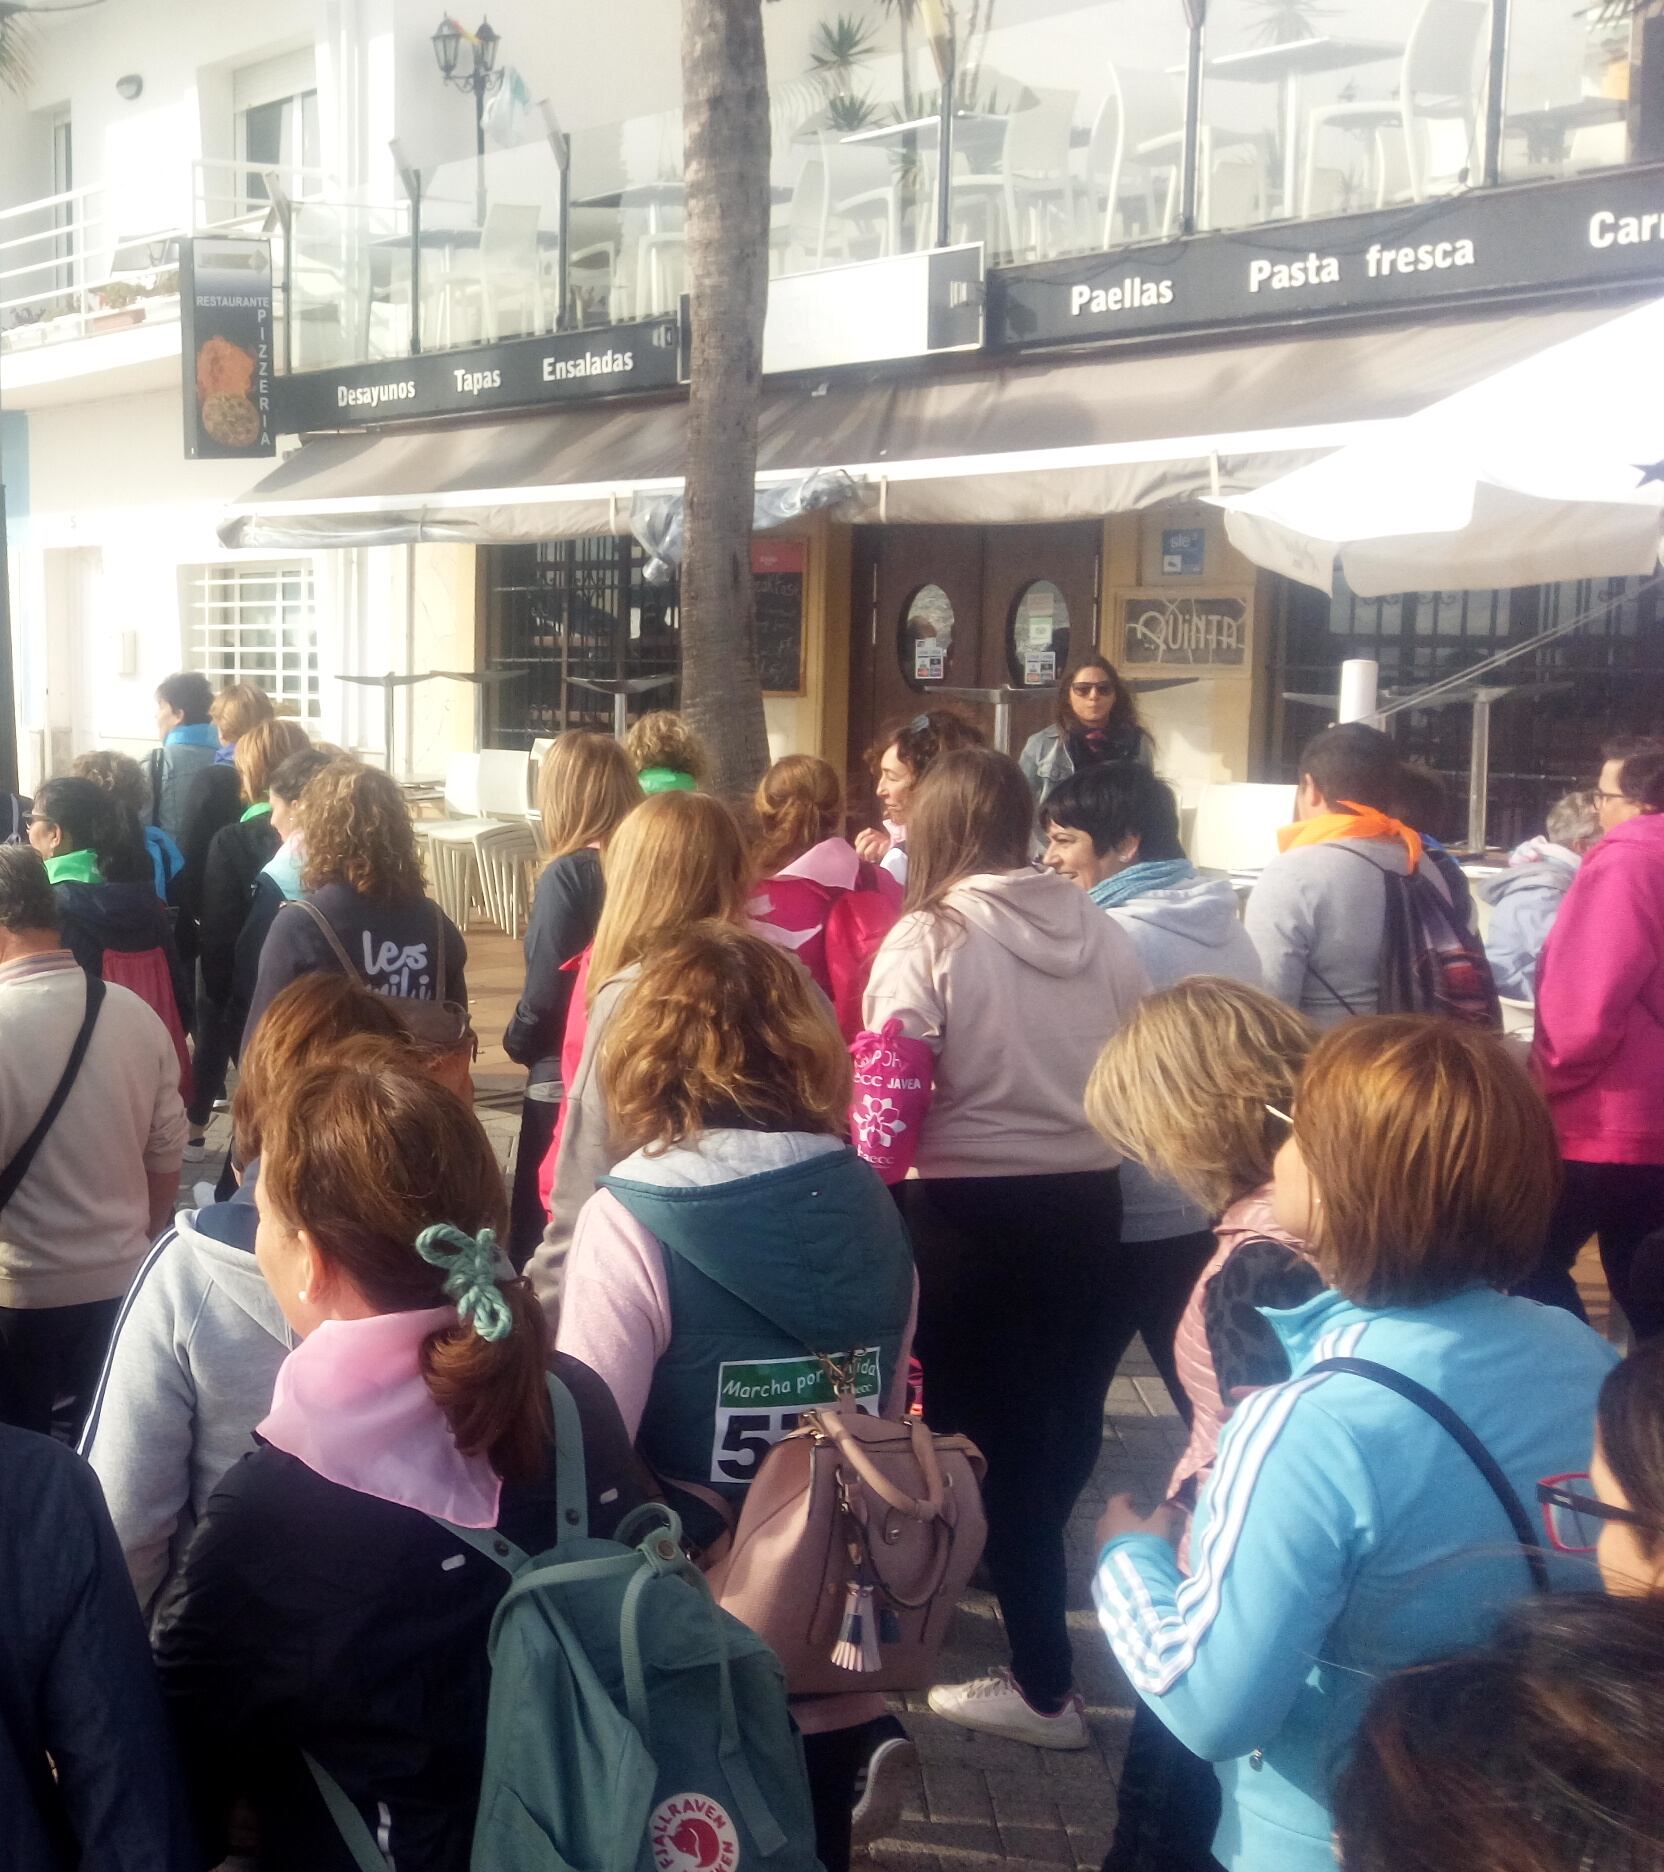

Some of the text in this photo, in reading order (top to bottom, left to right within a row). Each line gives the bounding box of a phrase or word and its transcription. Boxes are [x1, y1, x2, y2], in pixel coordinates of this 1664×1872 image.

[196, 295, 270, 308] RESTAURANTE
[1071, 277, 1174, 315] Paellas
[1249, 252, 1340, 293] Pasta
[1366, 238, 1475, 278] fresca
[256, 308, 271, 446] PIZZERIA
[337, 350, 634, 407] Desayunos Tapas Ensaladas
[722, 1378, 792, 1399] Marcha
[796, 1369, 825, 1394] por
